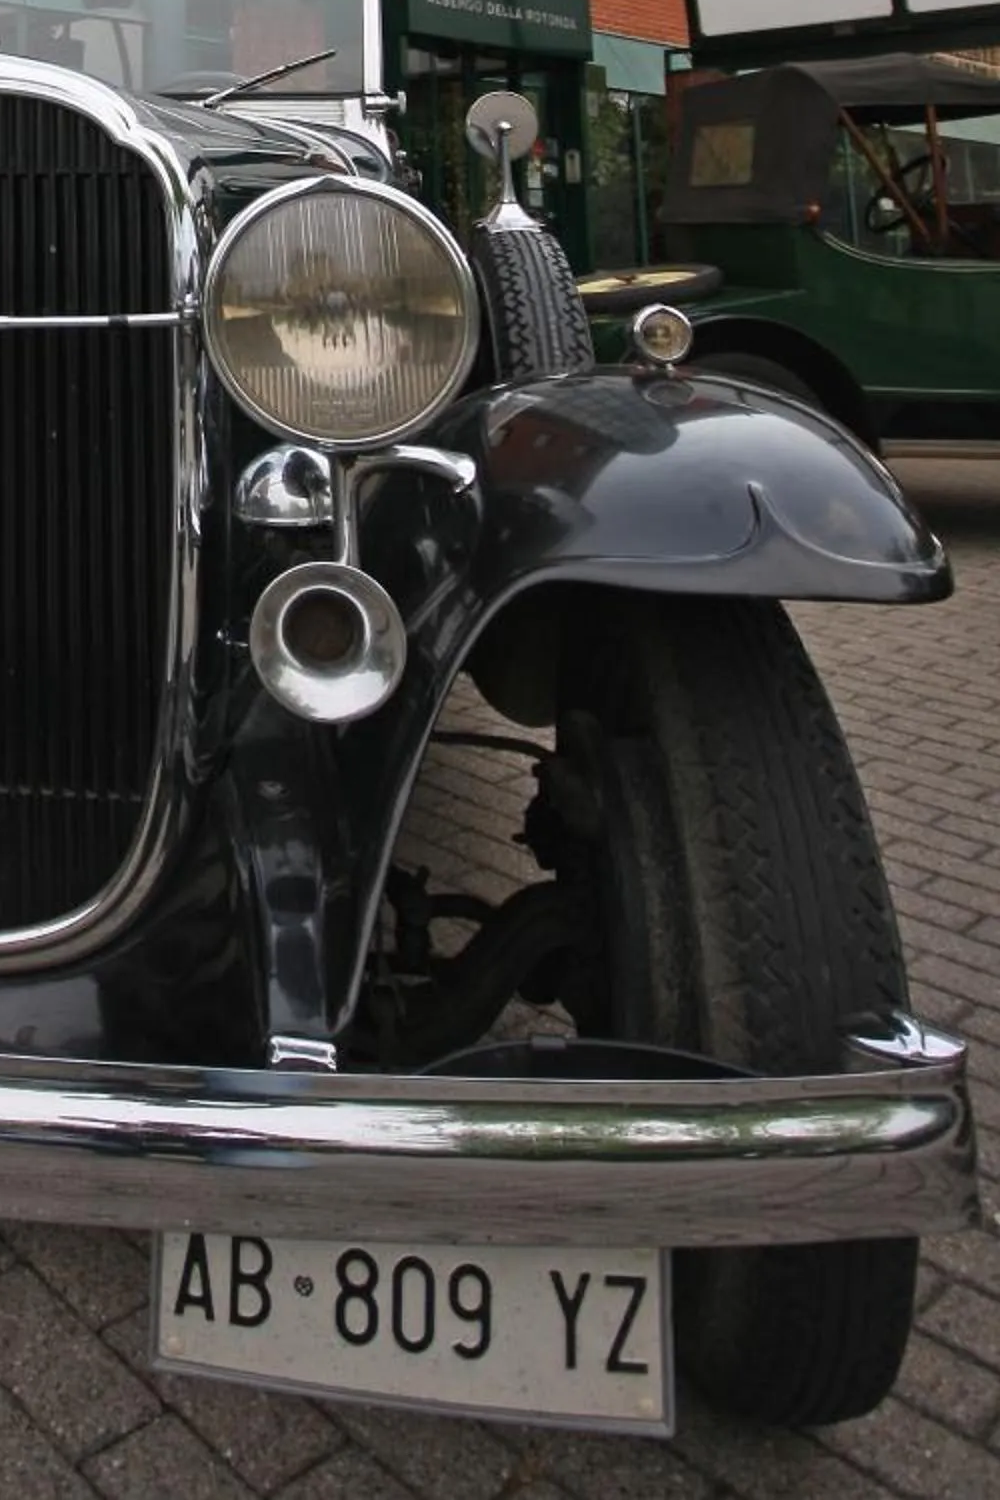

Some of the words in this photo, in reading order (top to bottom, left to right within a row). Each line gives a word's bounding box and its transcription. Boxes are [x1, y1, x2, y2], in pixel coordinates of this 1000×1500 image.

[487, 1, 523, 19] DELLA
[173, 1232, 274, 1328] AB
[335, 1247, 493, 1361] 809
[549, 1268, 650, 1375] YZ
